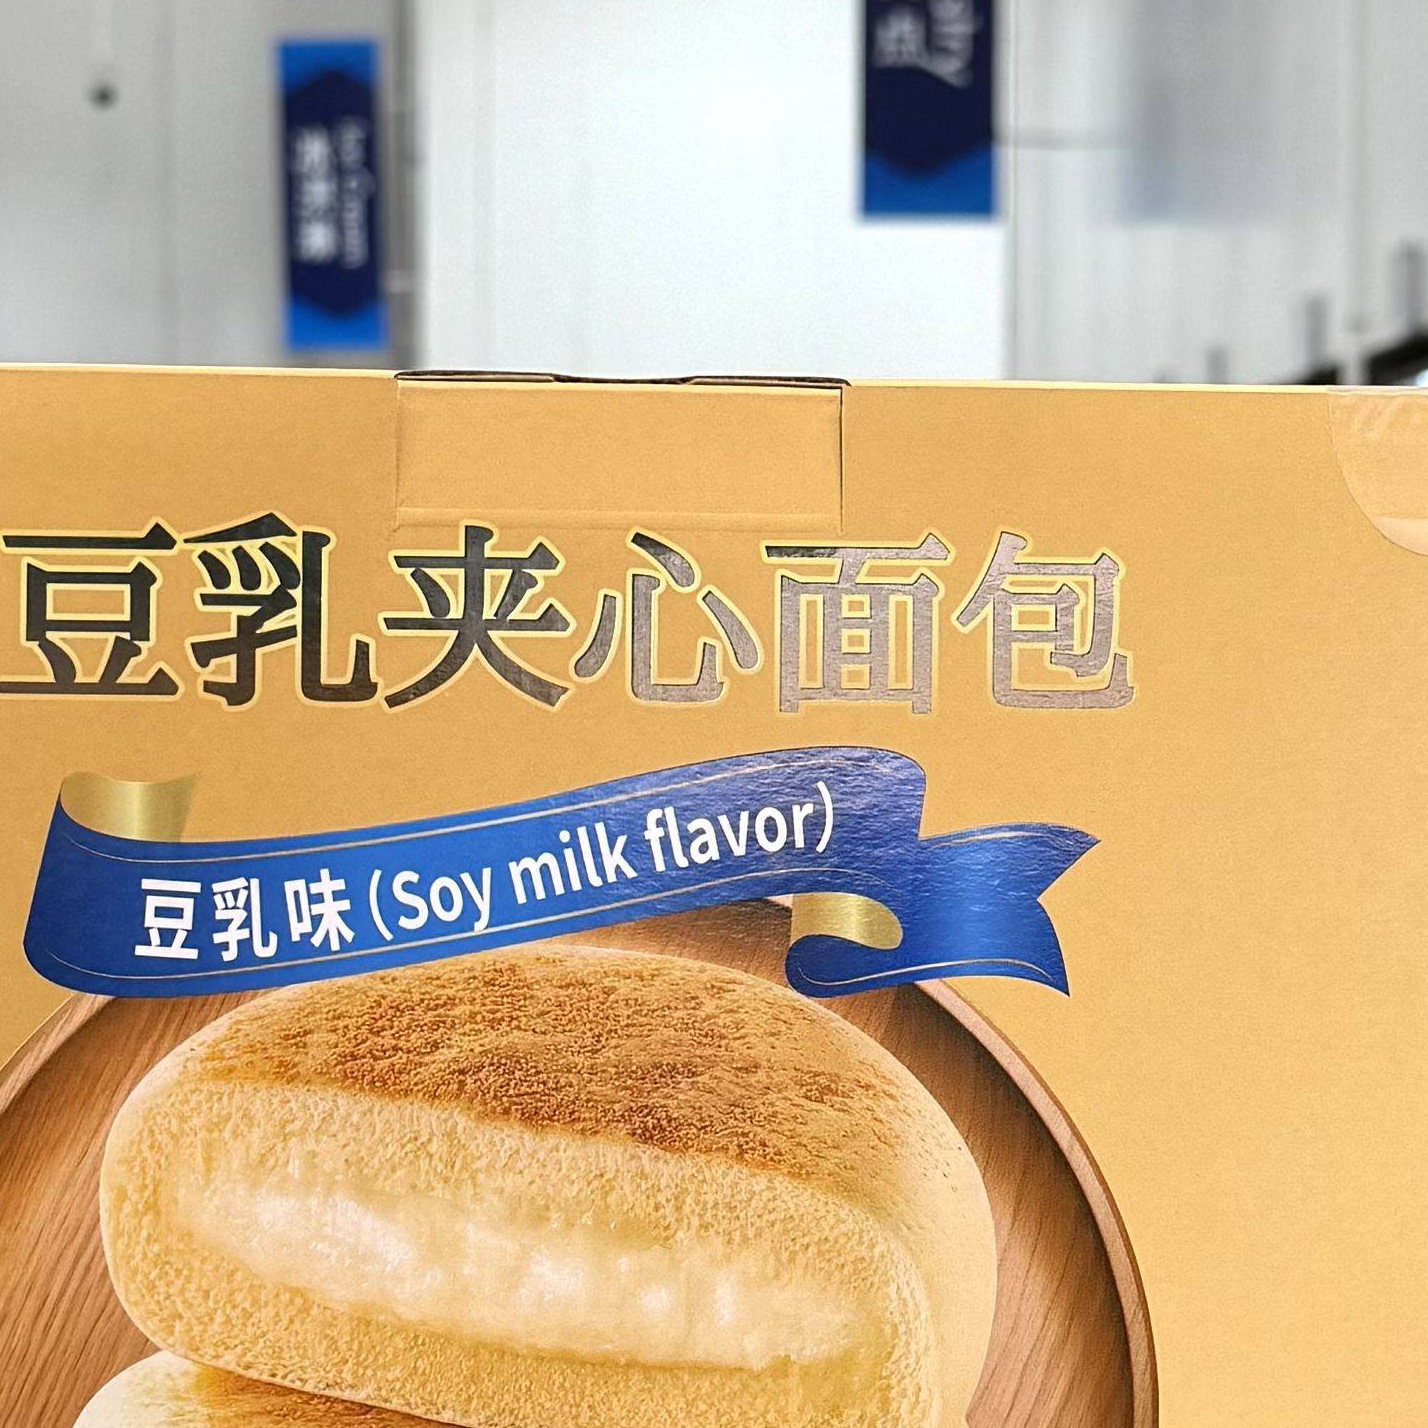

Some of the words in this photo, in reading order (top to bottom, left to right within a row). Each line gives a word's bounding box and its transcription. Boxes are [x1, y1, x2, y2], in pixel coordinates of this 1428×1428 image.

[134, 867, 354, 960] 豆乳味
[369, 869, 493, 942] (Soy
[509, 822, 638, 904] milk
[643, 781, 835, 884] flavor)
